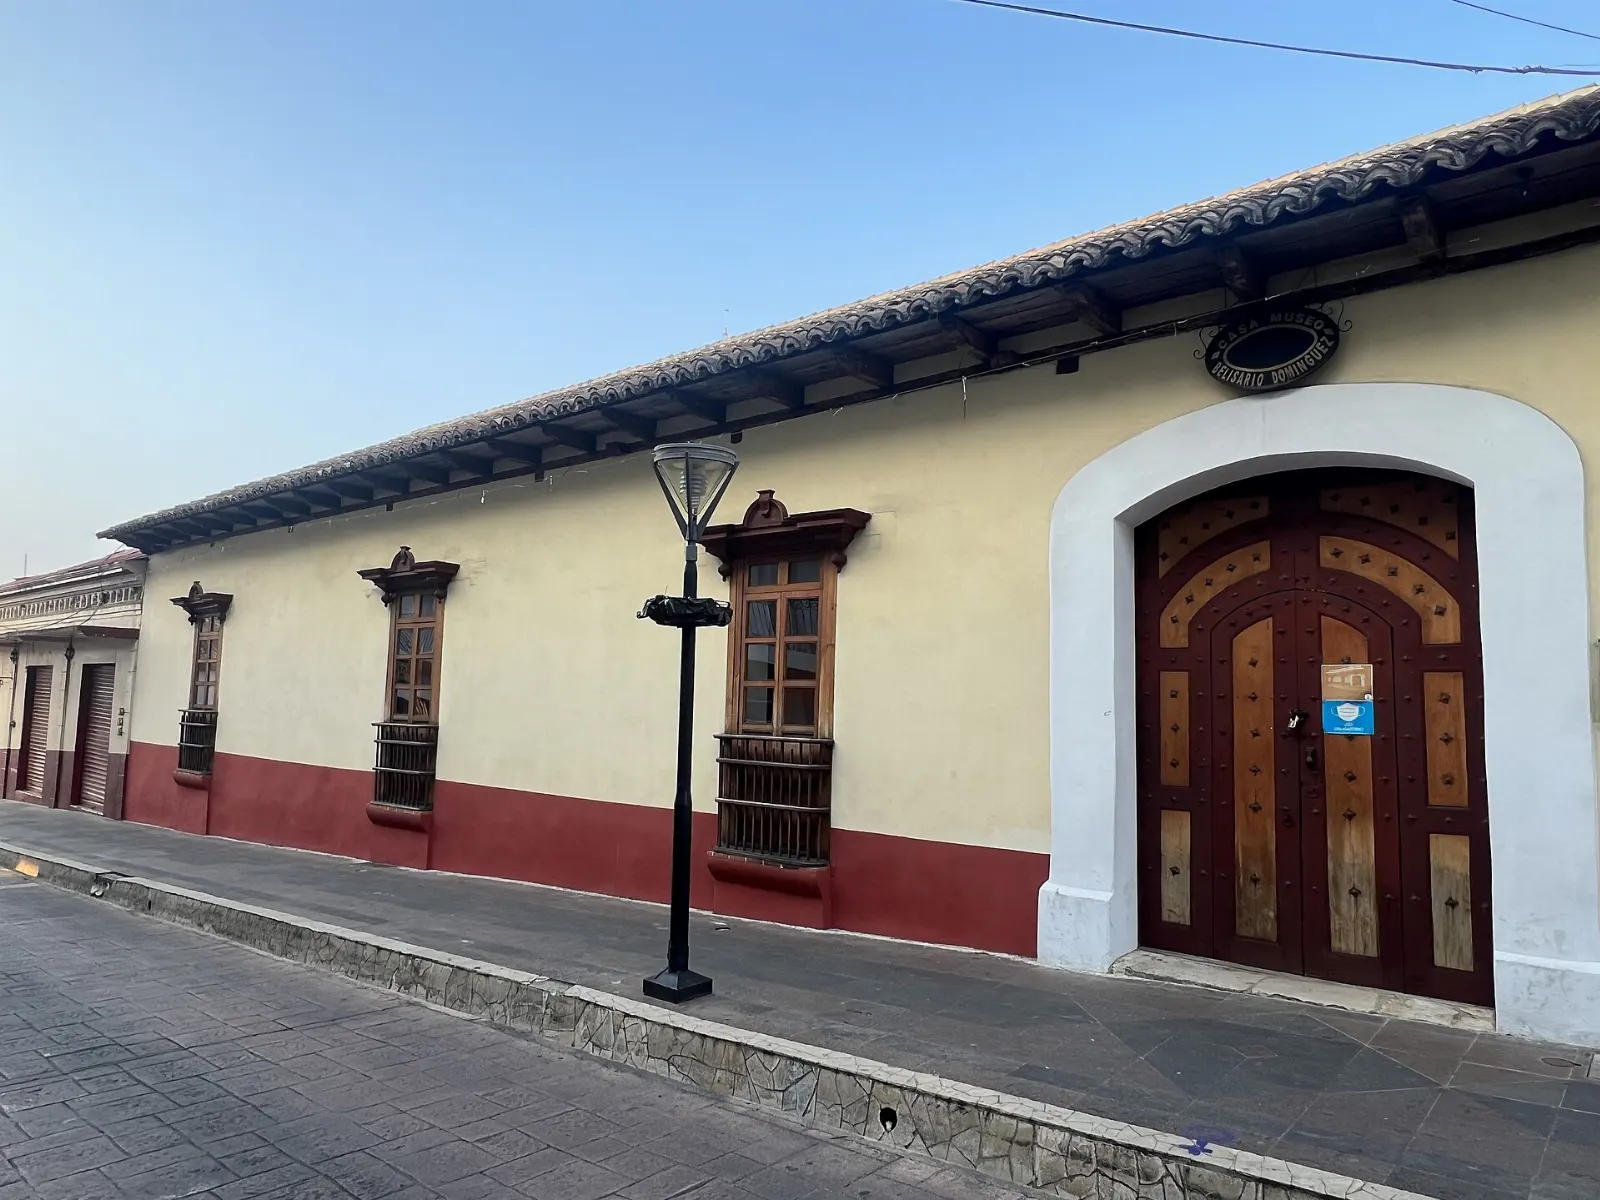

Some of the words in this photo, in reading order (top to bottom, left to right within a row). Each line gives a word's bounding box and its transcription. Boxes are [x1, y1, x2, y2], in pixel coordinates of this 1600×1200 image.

[1218, 318, 1259, 350] CASA
[1270, 312, 1325, 330] MUSEO
[1211, 362, 1264, 387] BELISARIO
[1271, 335, 1335, 384] DOMINGUEZ
